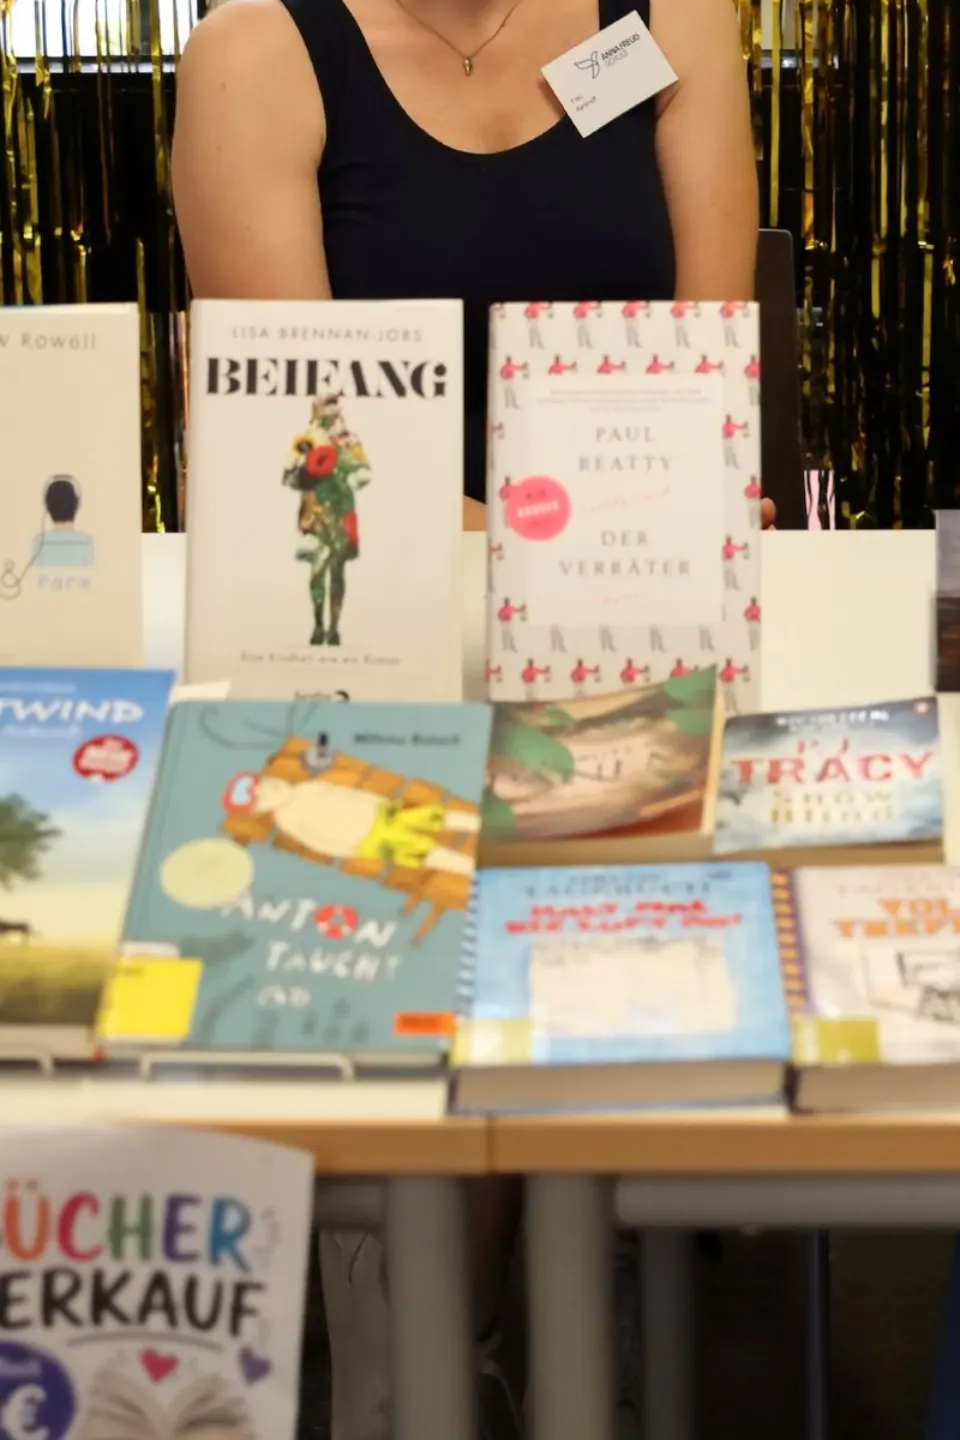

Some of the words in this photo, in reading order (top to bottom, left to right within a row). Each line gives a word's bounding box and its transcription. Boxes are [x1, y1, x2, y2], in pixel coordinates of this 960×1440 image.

[21, 332, 97, 351] Rowell
[232, 325, 270, 340] LISA
[206, 357, 448, 399] BEIFANG
[595, 427, 656, 442] PAUL
[578, 456, 674, 472] BEATTY
[600, 530, 649, 547] DER
[558, 557, 690, 577] VERRÄTER
[730, 749, 933, 786] TRACY
[0, 1177, 252, 1274] ÜCHER
[0, 1266, 266, 1338] ERKAUF
